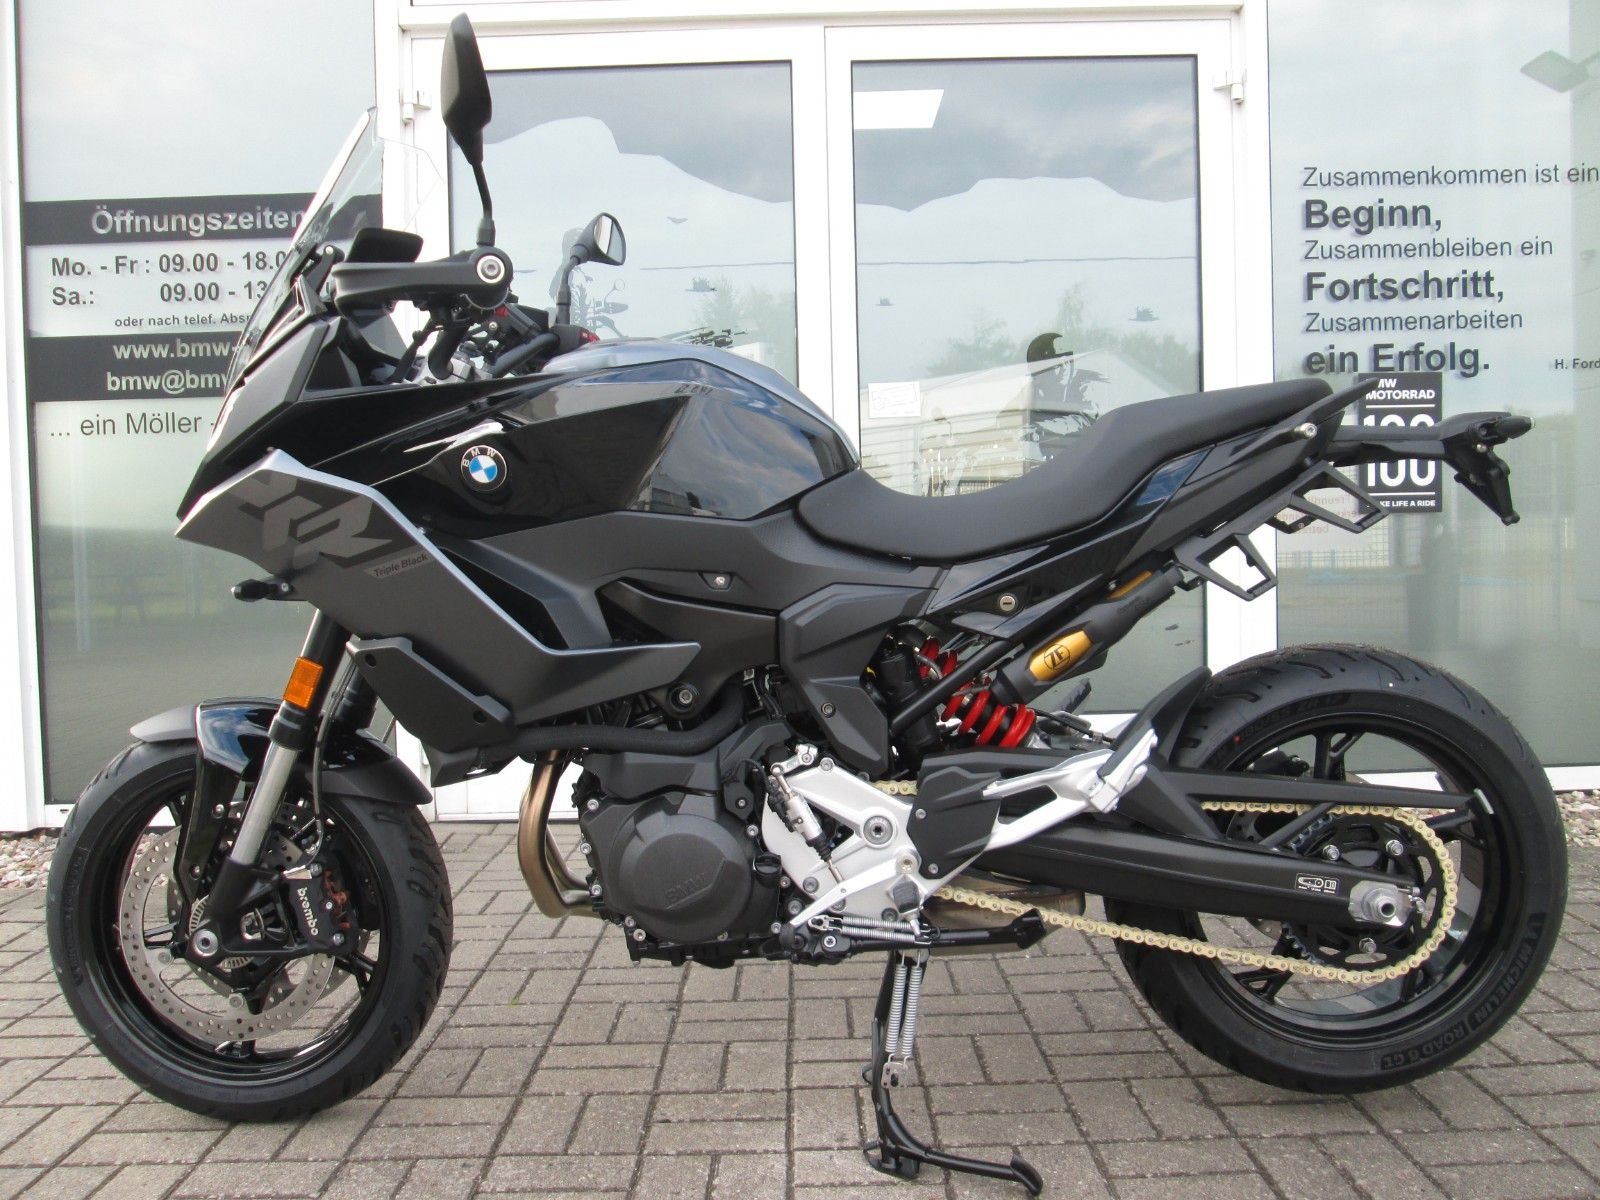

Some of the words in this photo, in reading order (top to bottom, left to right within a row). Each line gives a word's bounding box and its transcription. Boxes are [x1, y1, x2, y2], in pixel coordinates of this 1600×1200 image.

[1303, 165, 1527, 187] Zusammenkommen
[1535, 163, 1560, 183] ist
[1567, 162, 1600, 183] ein
[1304, 198, 1442, 235] Beginn,
[1304, 237, 1512, 260] Zusammenbleiben
[1520, 236, 1553, 256] ein
[51, 257, 92, 277] Mo.
[158, 252, 219, 273] 09.00
[52, 286, 94, 306] Sa.:
[160, 282, 220, 302] 09.00
[1305, 269, 1504, 303] Fortschritt,
[114, 316, 144, 327] oder
[148, 314, 180, 326] nach
[184, 313, 216, 325] telef.
[1305, 310, 1523, 333] Zusammenarbeiten
[1306, 345, 1359, 374] ein
[1372, 341, 1490, 378] Erfolg.
[1554, 359, 1568, 370] H.
[1366, 389, 1435, 400] MOTORRAD
[80, 414, 116, 435] ein
[126, 412, 202, 434] Möller
[462, 447, 496, 467] BMW
[374, 563, 401, 577] Triple
[401, 553, 428, 569] Black
[297, 887, 319, 936] brembo
[1473, 943, 1534, 1027] MICHELIN
[1422, 1022, 1470, 1056] ROAD
